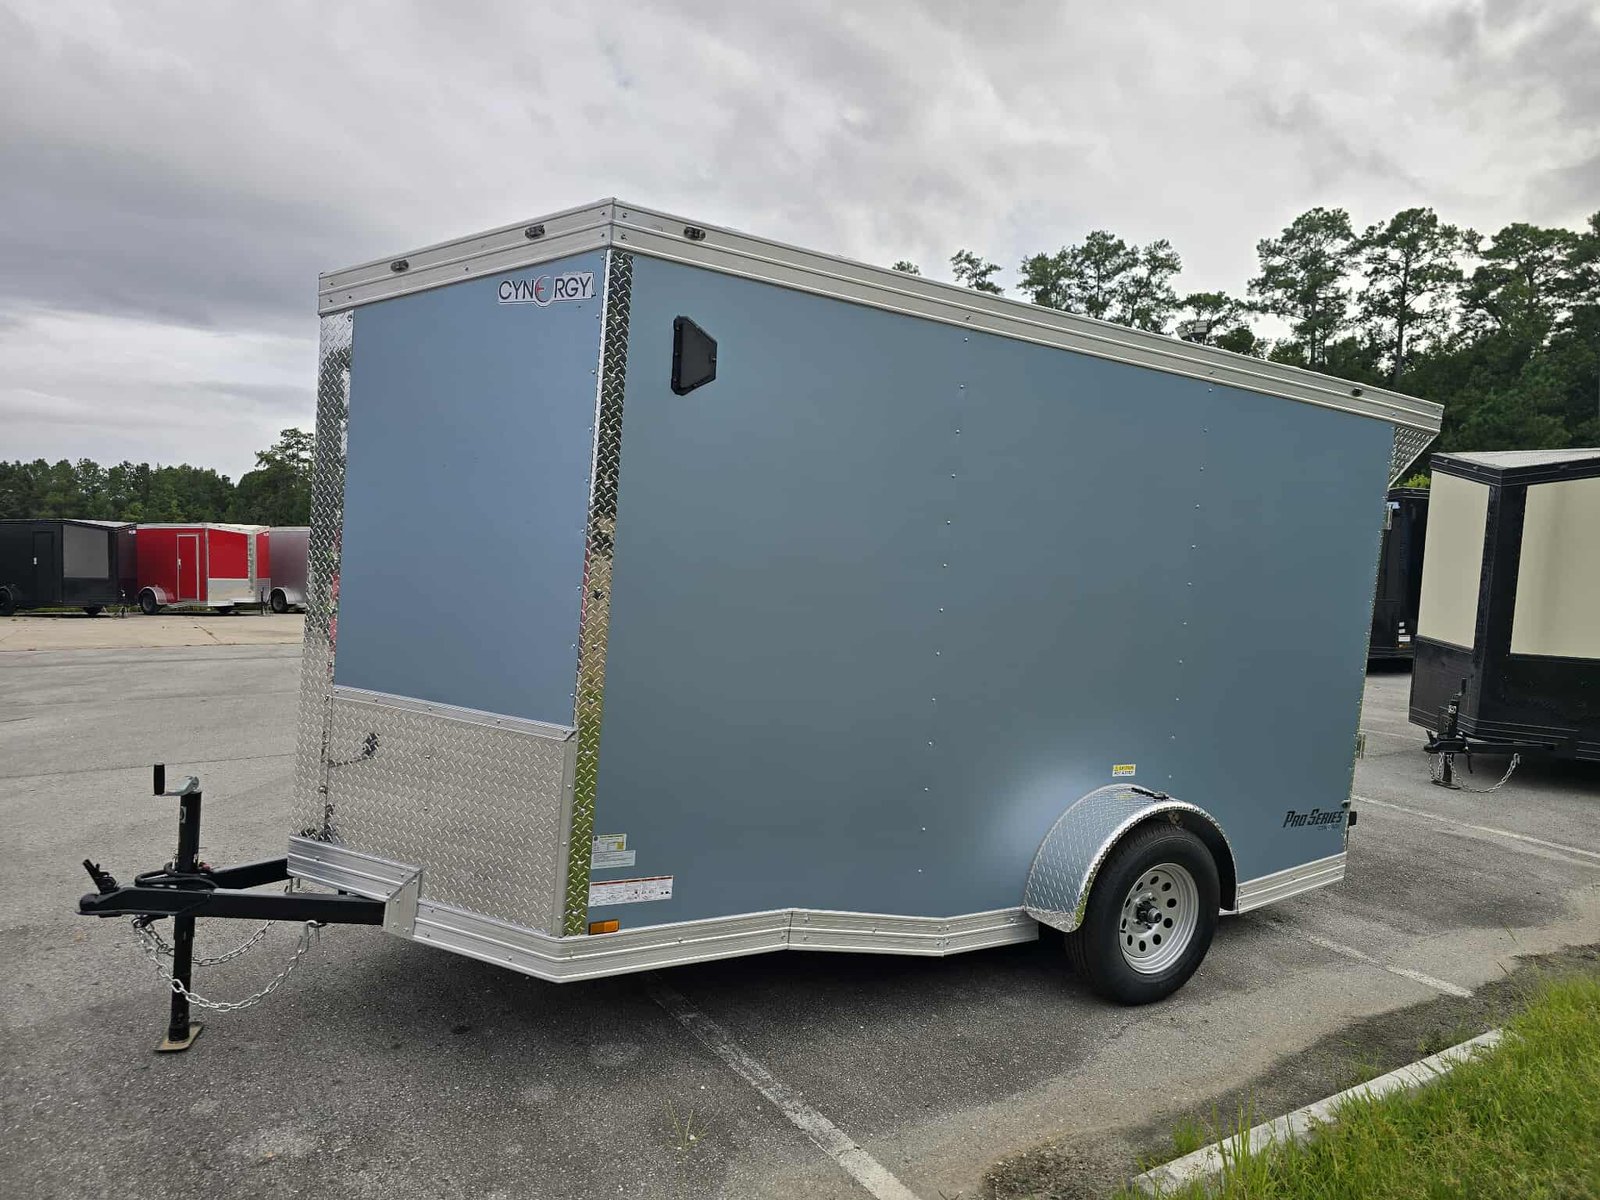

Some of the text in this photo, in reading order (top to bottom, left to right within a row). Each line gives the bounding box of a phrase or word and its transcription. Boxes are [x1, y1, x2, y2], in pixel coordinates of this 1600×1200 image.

[499, 276, 591, 302] CYNERGY
[1283, 808, 1344, 828] PRO SERIES
